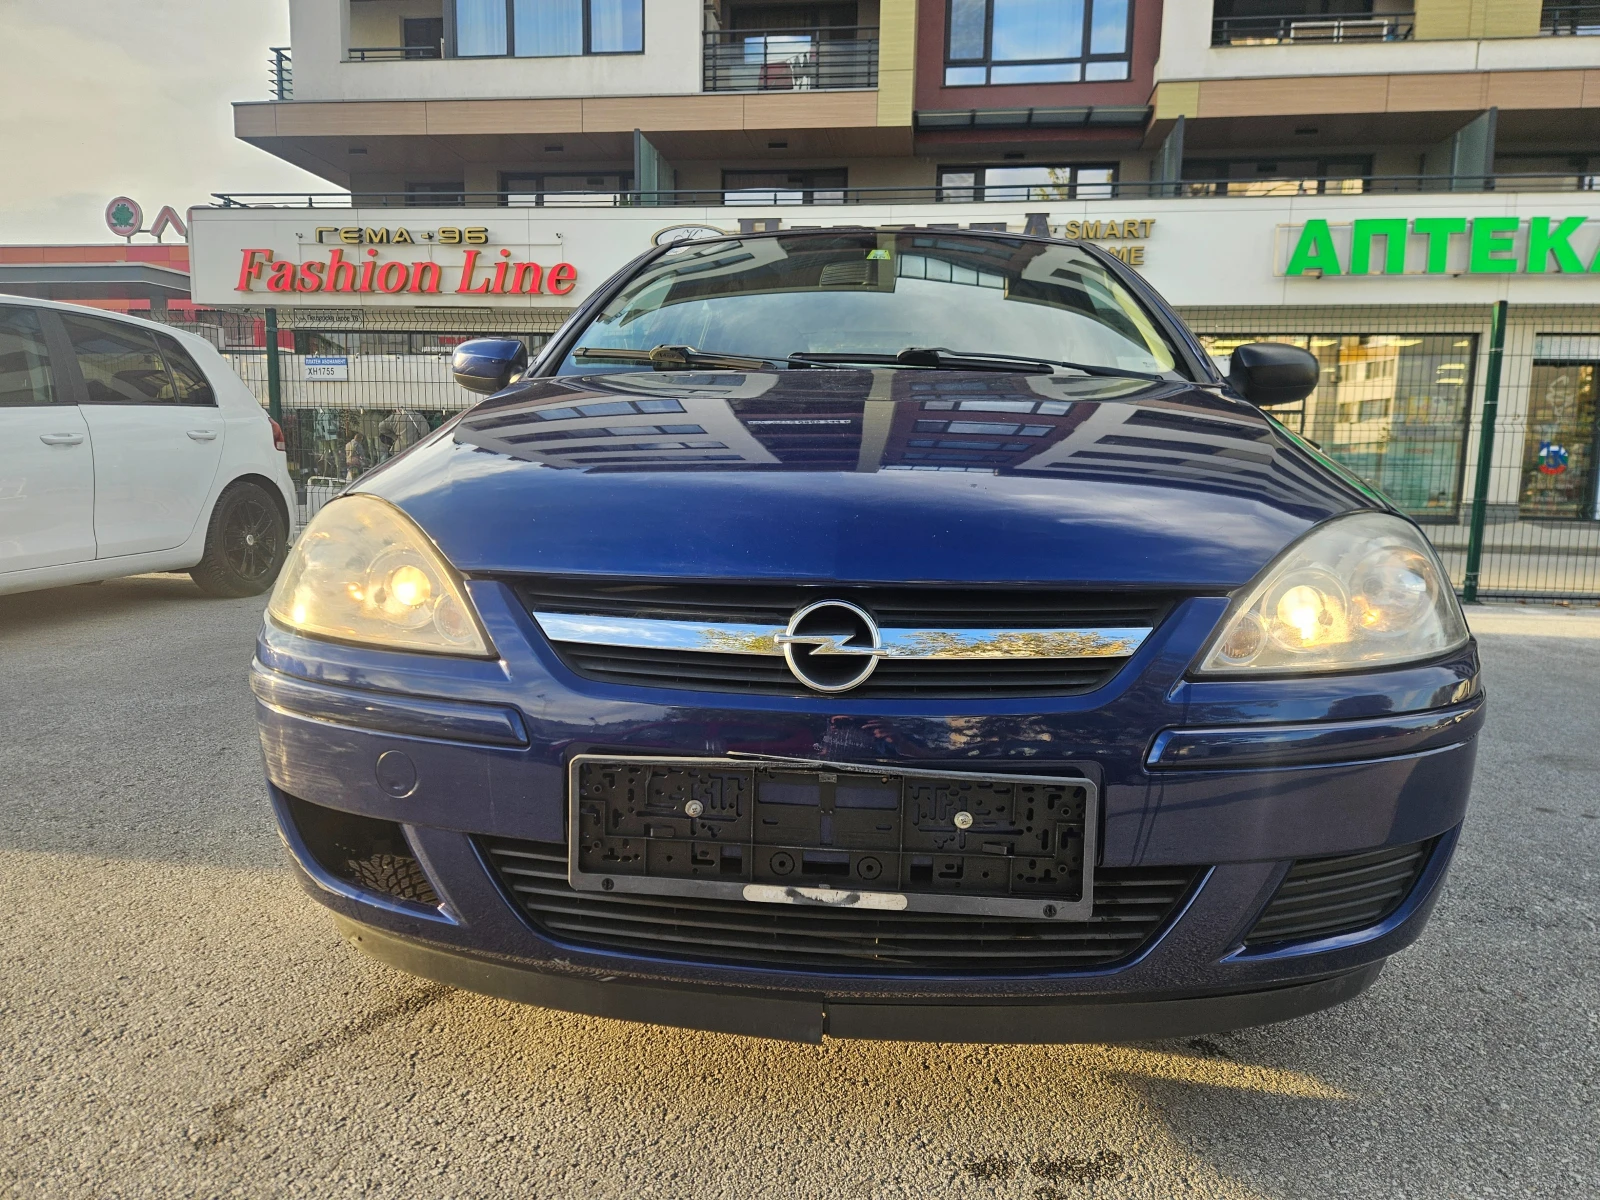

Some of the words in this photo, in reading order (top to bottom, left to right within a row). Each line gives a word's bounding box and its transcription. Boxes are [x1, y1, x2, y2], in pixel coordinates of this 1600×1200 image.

[1065, 219, 1156, 239] SMART
[1286, 216, 1600, 276] АПТЕК
[234, 248, 442, 293] Fashion
[455, 249, 577, 295] Line
